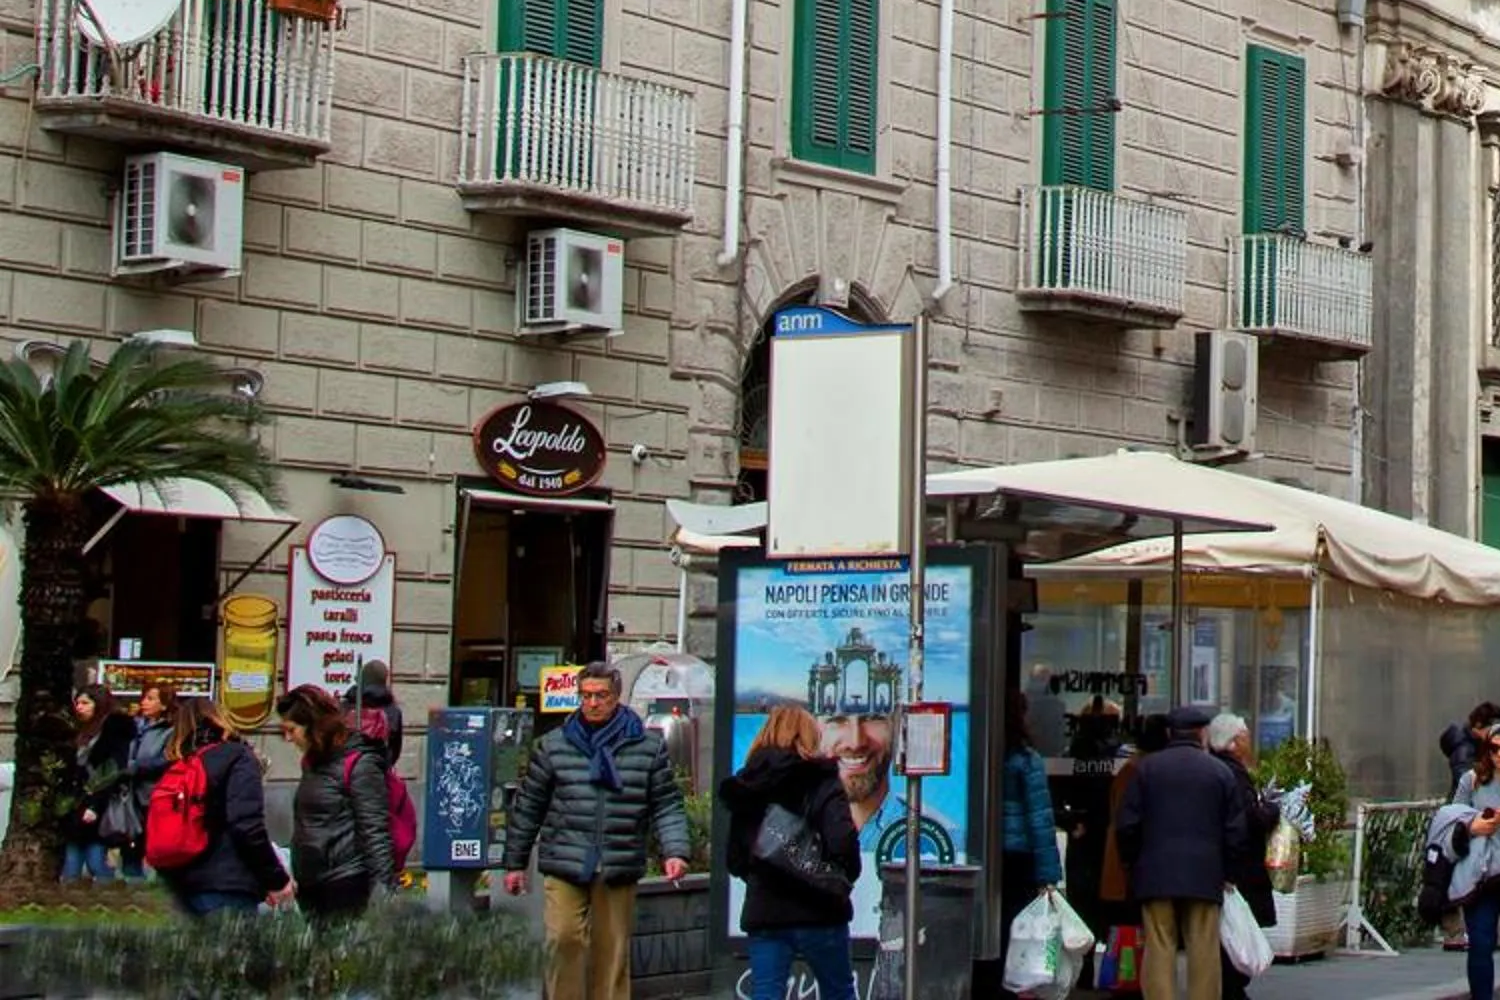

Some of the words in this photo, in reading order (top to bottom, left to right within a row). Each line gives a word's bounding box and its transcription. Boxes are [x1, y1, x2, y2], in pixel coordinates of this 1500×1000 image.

[778, 312, 823, 332] anm
[493, 405, 586, 460] Leopoldo
[518, 473, 536, 488] dal
[786, 560, 834, 572] FERMATA
[838, 560, 845, 570] A
[848, 559, 902, 570] RICHIESTA
[311, 587, 371, 605] pasticceria
[764, 584, 817, 604] NAPOLI
[821, 583, 869, 603] PENSA
[871, 583, 887, 602] IN
[890, 582, 950, 602] GRNDE
[323, 607, 358, 623] taralli
[306, 630, 337, 647] pasta
[340, 628, 373, 644] fresca
[324, 671, 351, 684] torte
[454, 842, 478, 858] BNE
